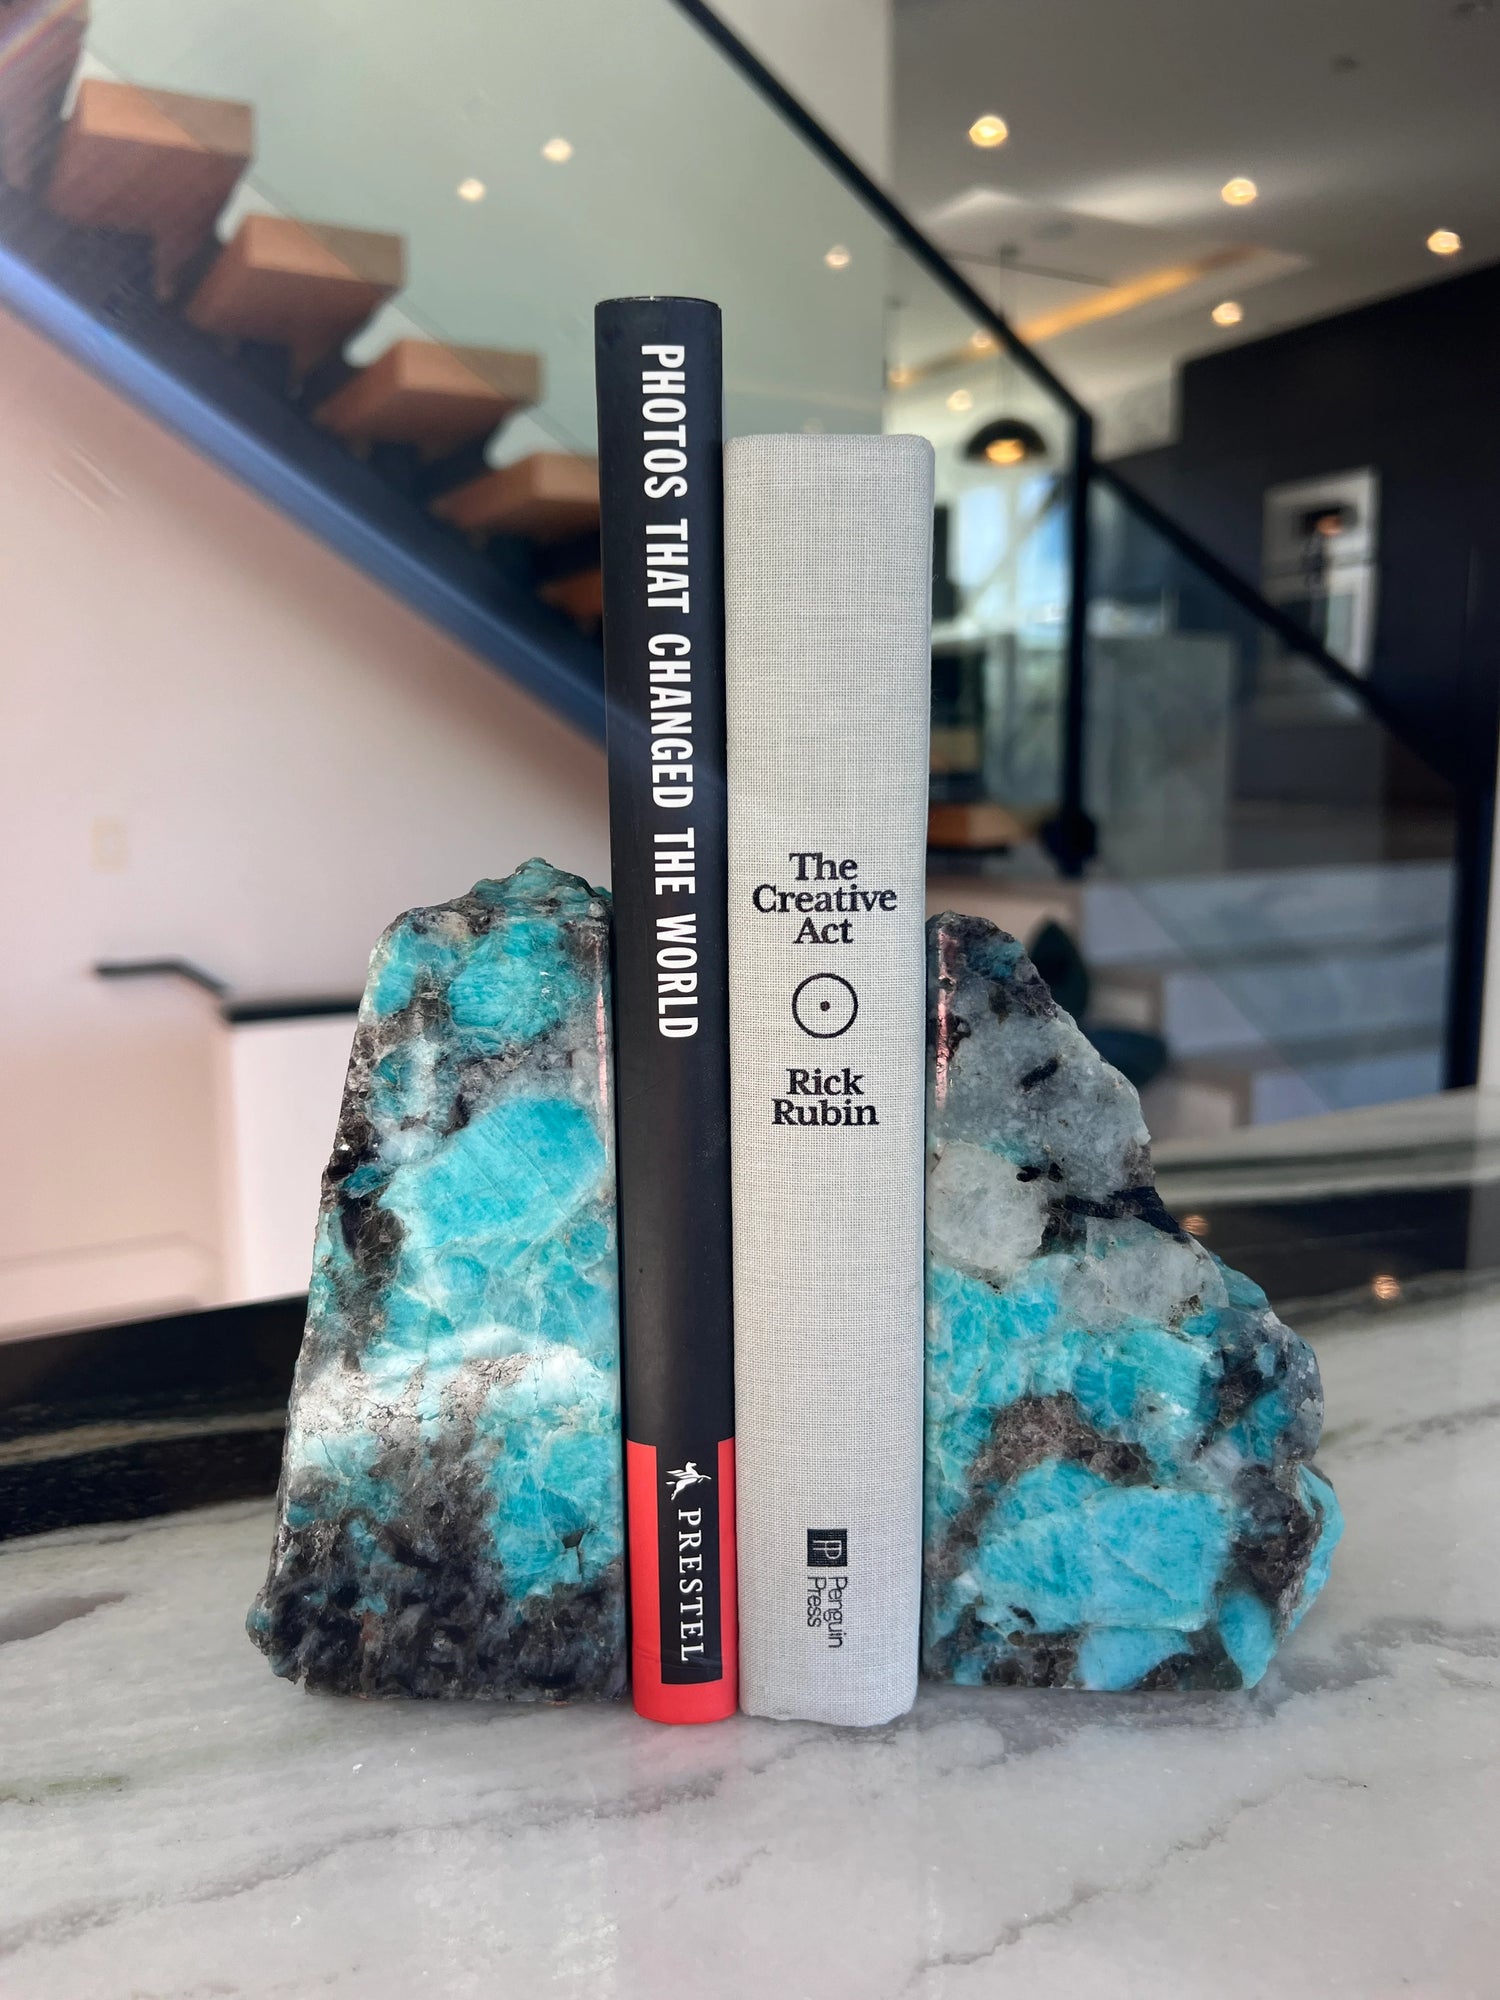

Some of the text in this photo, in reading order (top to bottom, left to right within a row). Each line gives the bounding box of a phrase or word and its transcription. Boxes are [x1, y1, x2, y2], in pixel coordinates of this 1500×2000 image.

[641, 344, 700, 1038] PHOTOS THAT CHANGED THE WORLD
[788, 851, 858, 881] The
[752, 883, 898, 914] Creative
[792, 916, 854, 945] Act
[786, 1067, 864, 1096] Rick
[771, 1098, 879, 1127] Rubin
[677, 1507, 705, 1662] PRESTEL
[806, 1575, 827, 1629] Press
[823, 1575, 848, 1649] Penguin
